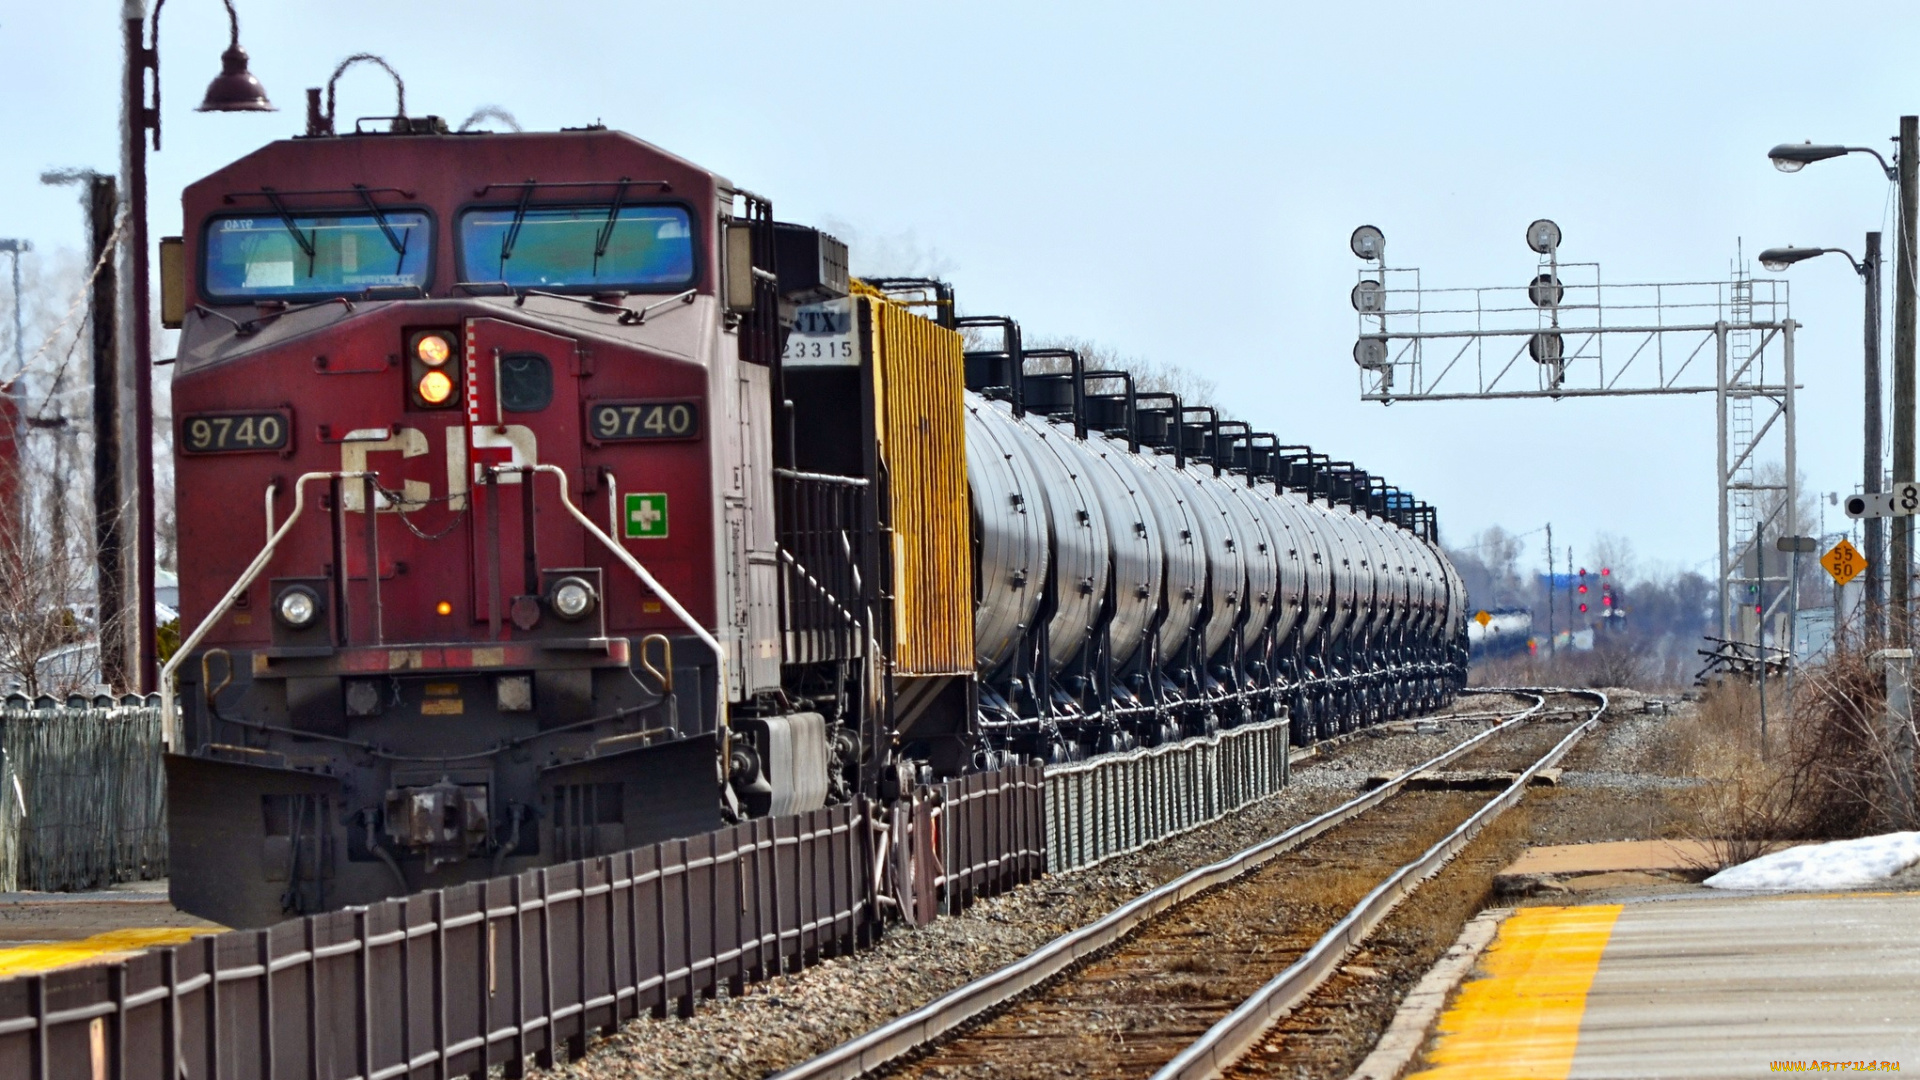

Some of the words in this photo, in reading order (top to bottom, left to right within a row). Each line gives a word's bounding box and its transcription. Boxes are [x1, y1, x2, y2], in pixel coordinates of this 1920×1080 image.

[191, 417, 279, 448] 9740
[599, 405, 689, 436] 9740
[341, 424, 538, 513] CP
[1833, 563, 1853, 577] 50
[1834, 548, 1853, 562] 55
